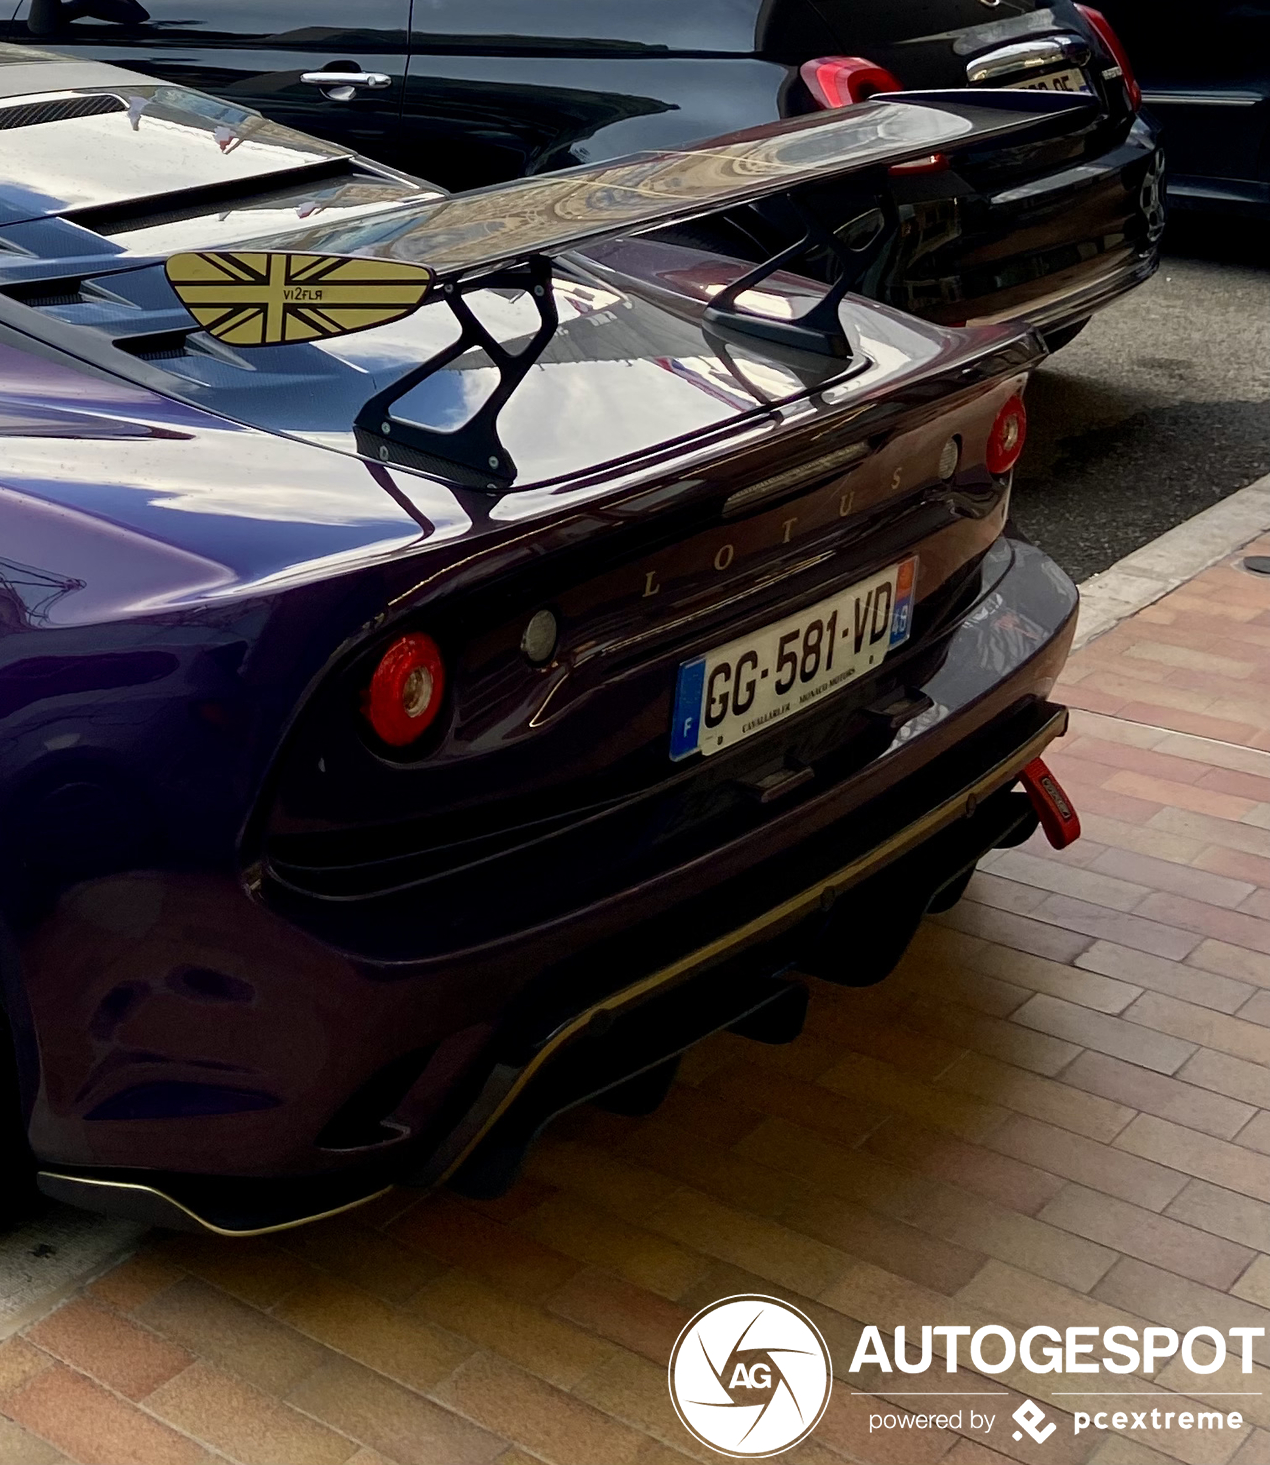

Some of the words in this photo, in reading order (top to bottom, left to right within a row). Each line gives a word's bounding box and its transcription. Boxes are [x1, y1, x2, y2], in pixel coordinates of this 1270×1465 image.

[642, 467, 903, 598] LOTUS
[683, 717, 693, 738] F
[704, 581, 892, 729] GG-581-VD
